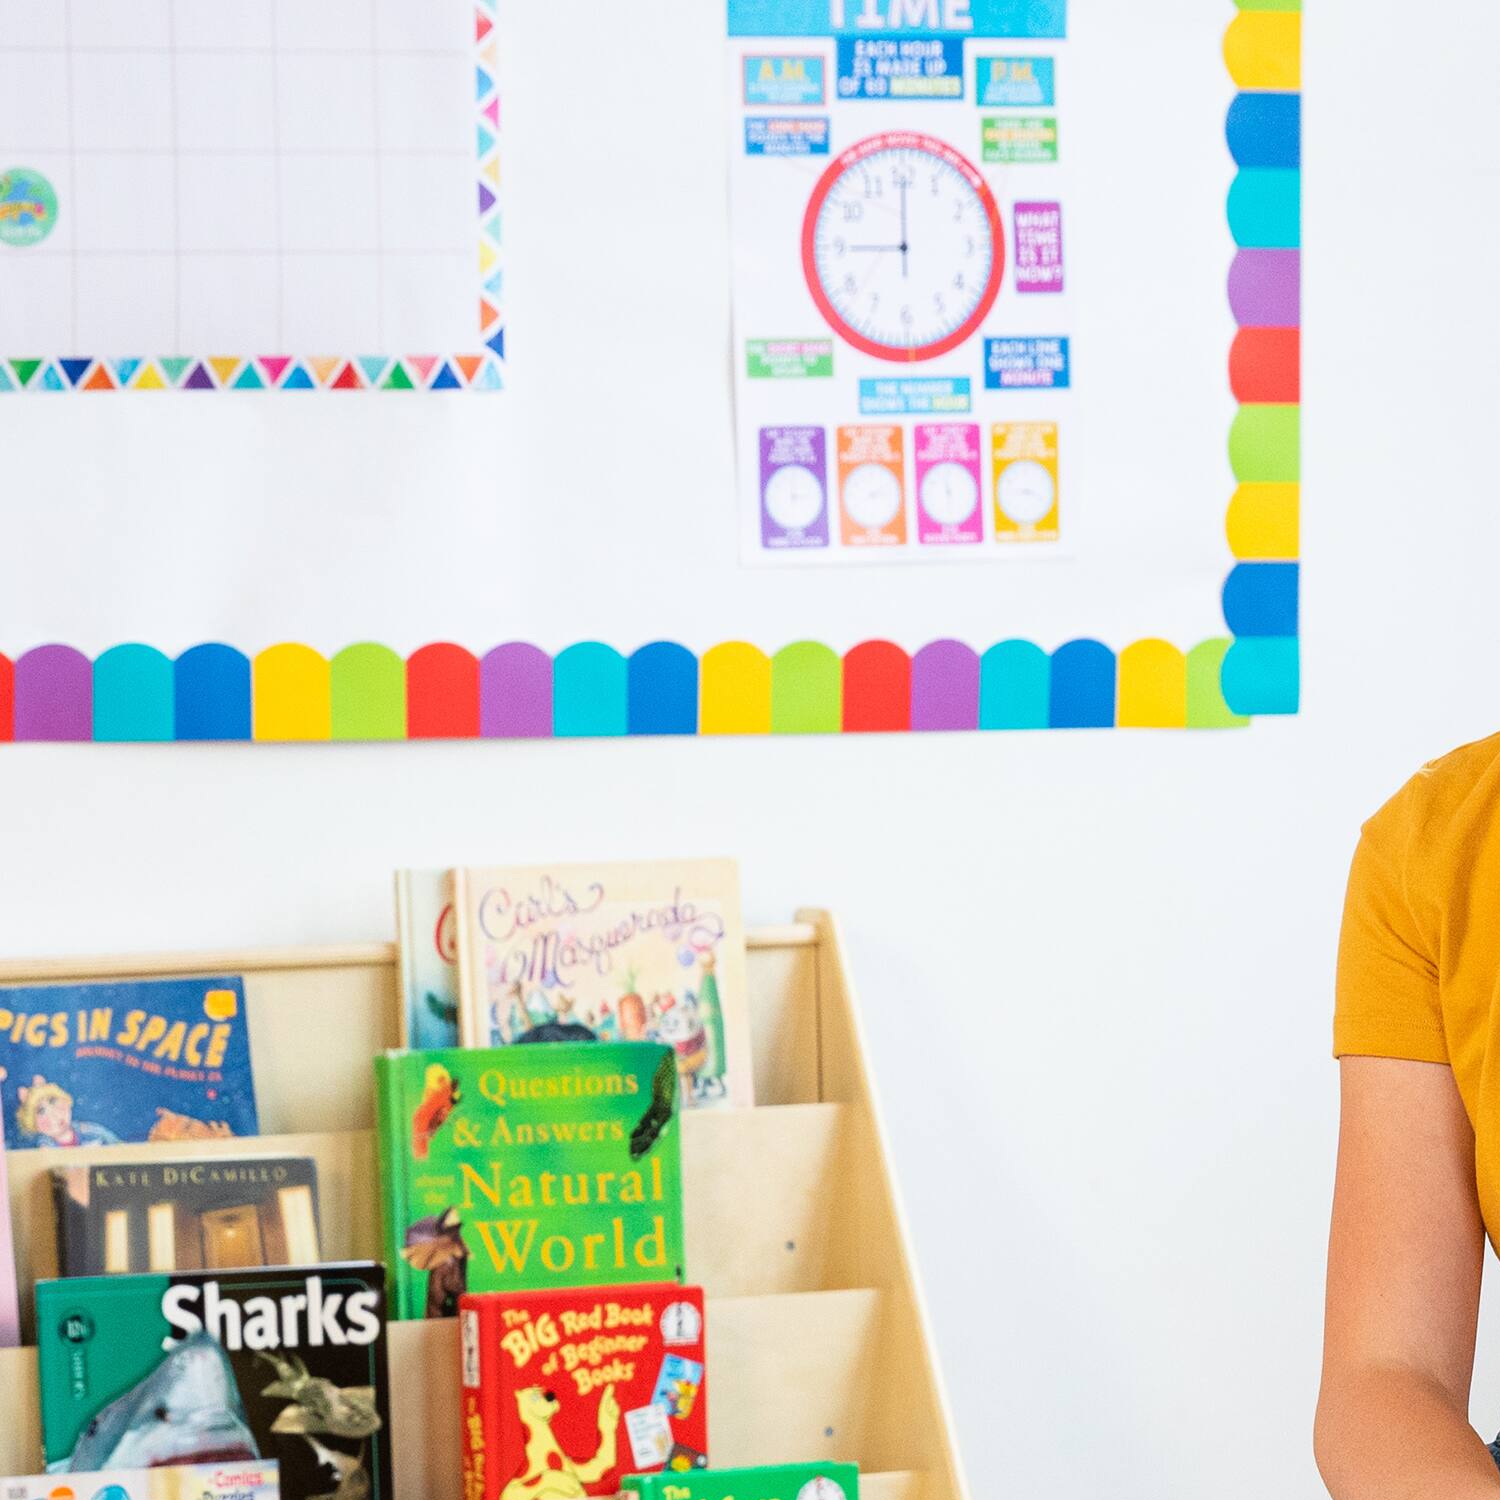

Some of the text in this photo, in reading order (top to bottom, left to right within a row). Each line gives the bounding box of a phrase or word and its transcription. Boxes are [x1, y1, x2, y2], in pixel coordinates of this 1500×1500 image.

[0, 1008, 68, 1048] PIGS
[77, 1007, 113, 1043] IN
[116, 1009, 232, 1067] SPACE
[478, 1068, 639, 1107] Questions
[453, 1115, 625, 1147] & Answers
[458, 1156, 664, 1209] Natural
[476, 1215, 668, 1274] World
[161, 1275, 382, 1351] Sharks
[500, 1313, 560, 1368] BIG
[559, 1304, 602, 1336] Red
[603, 1302, 653, 1329] Book
